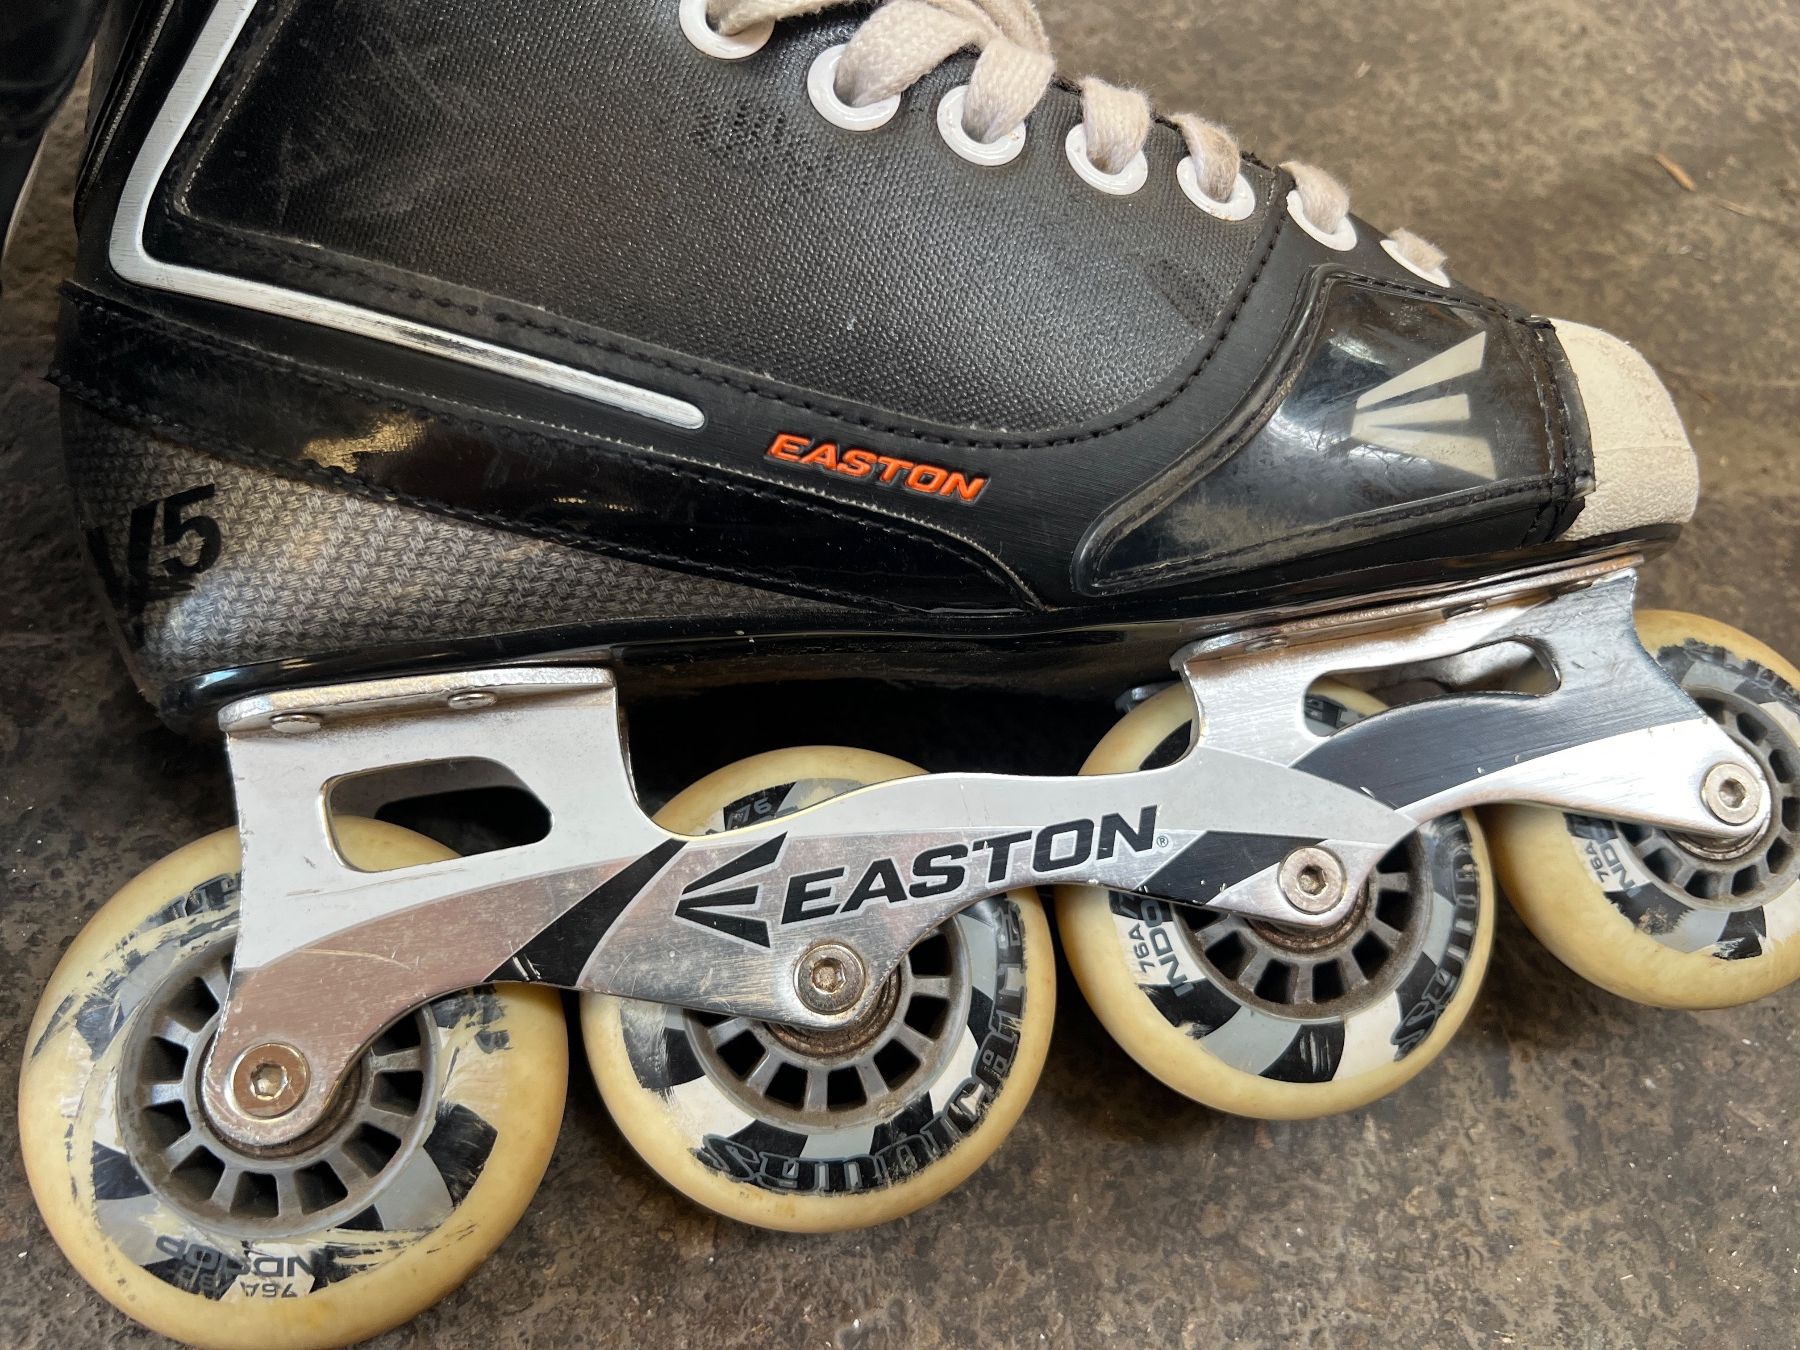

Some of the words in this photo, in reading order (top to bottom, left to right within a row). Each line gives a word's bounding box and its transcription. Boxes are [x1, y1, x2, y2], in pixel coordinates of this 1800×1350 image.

[767, 433, 986, 503] EASTON
[781, 805, 1158, 925] EASTON
[1585, 841, 1611, 883] 76A
[1128, 922, 1156, 974] 76A
[1140, 899, 1195, 998] INDO
[239, 1280, 298, 1298] 76A
